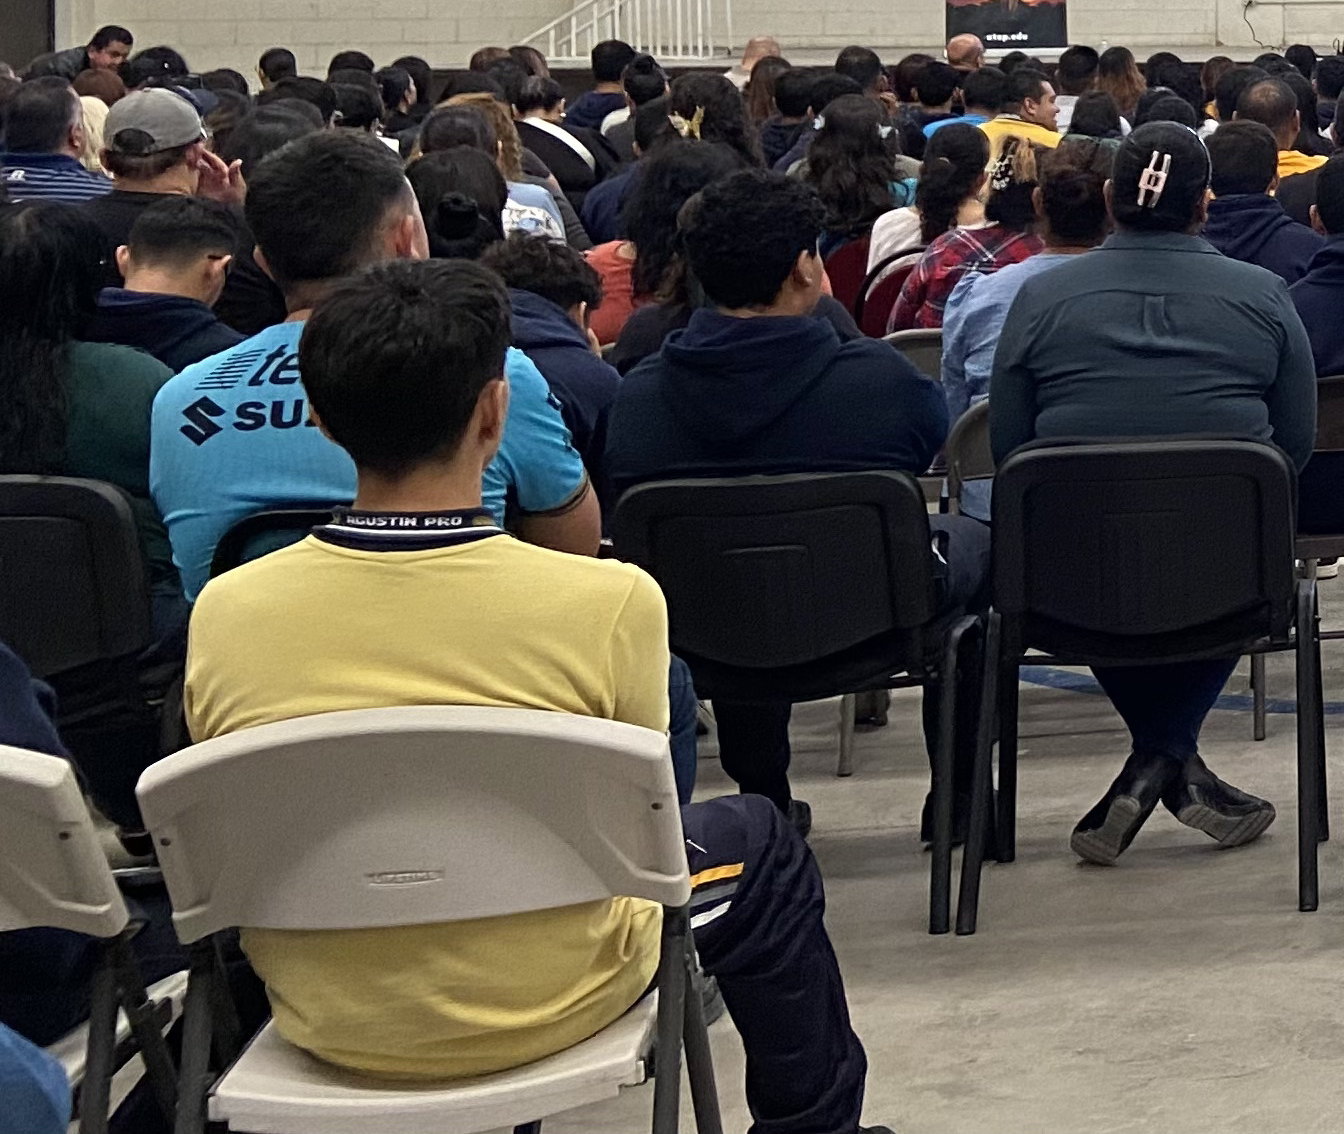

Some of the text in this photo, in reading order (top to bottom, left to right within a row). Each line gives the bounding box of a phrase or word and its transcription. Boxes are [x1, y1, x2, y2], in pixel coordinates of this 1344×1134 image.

[232, 398, 319, 432] SU
[346, 515, 462, 527] AGUSTIN PRO
